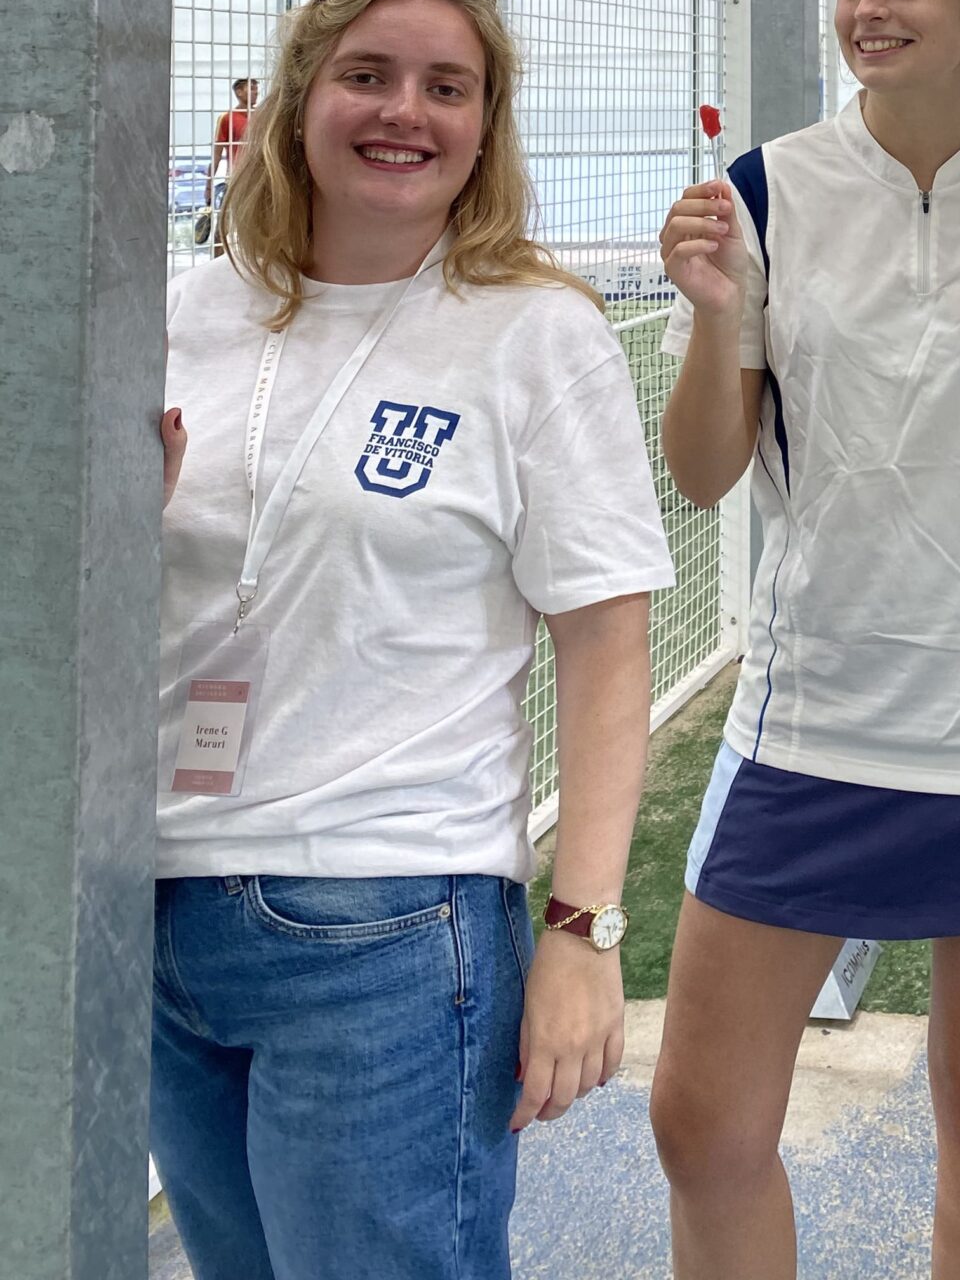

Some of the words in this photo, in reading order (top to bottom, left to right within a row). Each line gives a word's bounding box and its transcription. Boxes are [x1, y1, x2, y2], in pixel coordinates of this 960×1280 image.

[363, 443, 382, 456] DE
[383, 446, 434, 469] VITORIA
[367, 432, 440, 458] FRANCISCO
[196, 725, 220, 736] Irene
[221, 726, 228, 736] G
